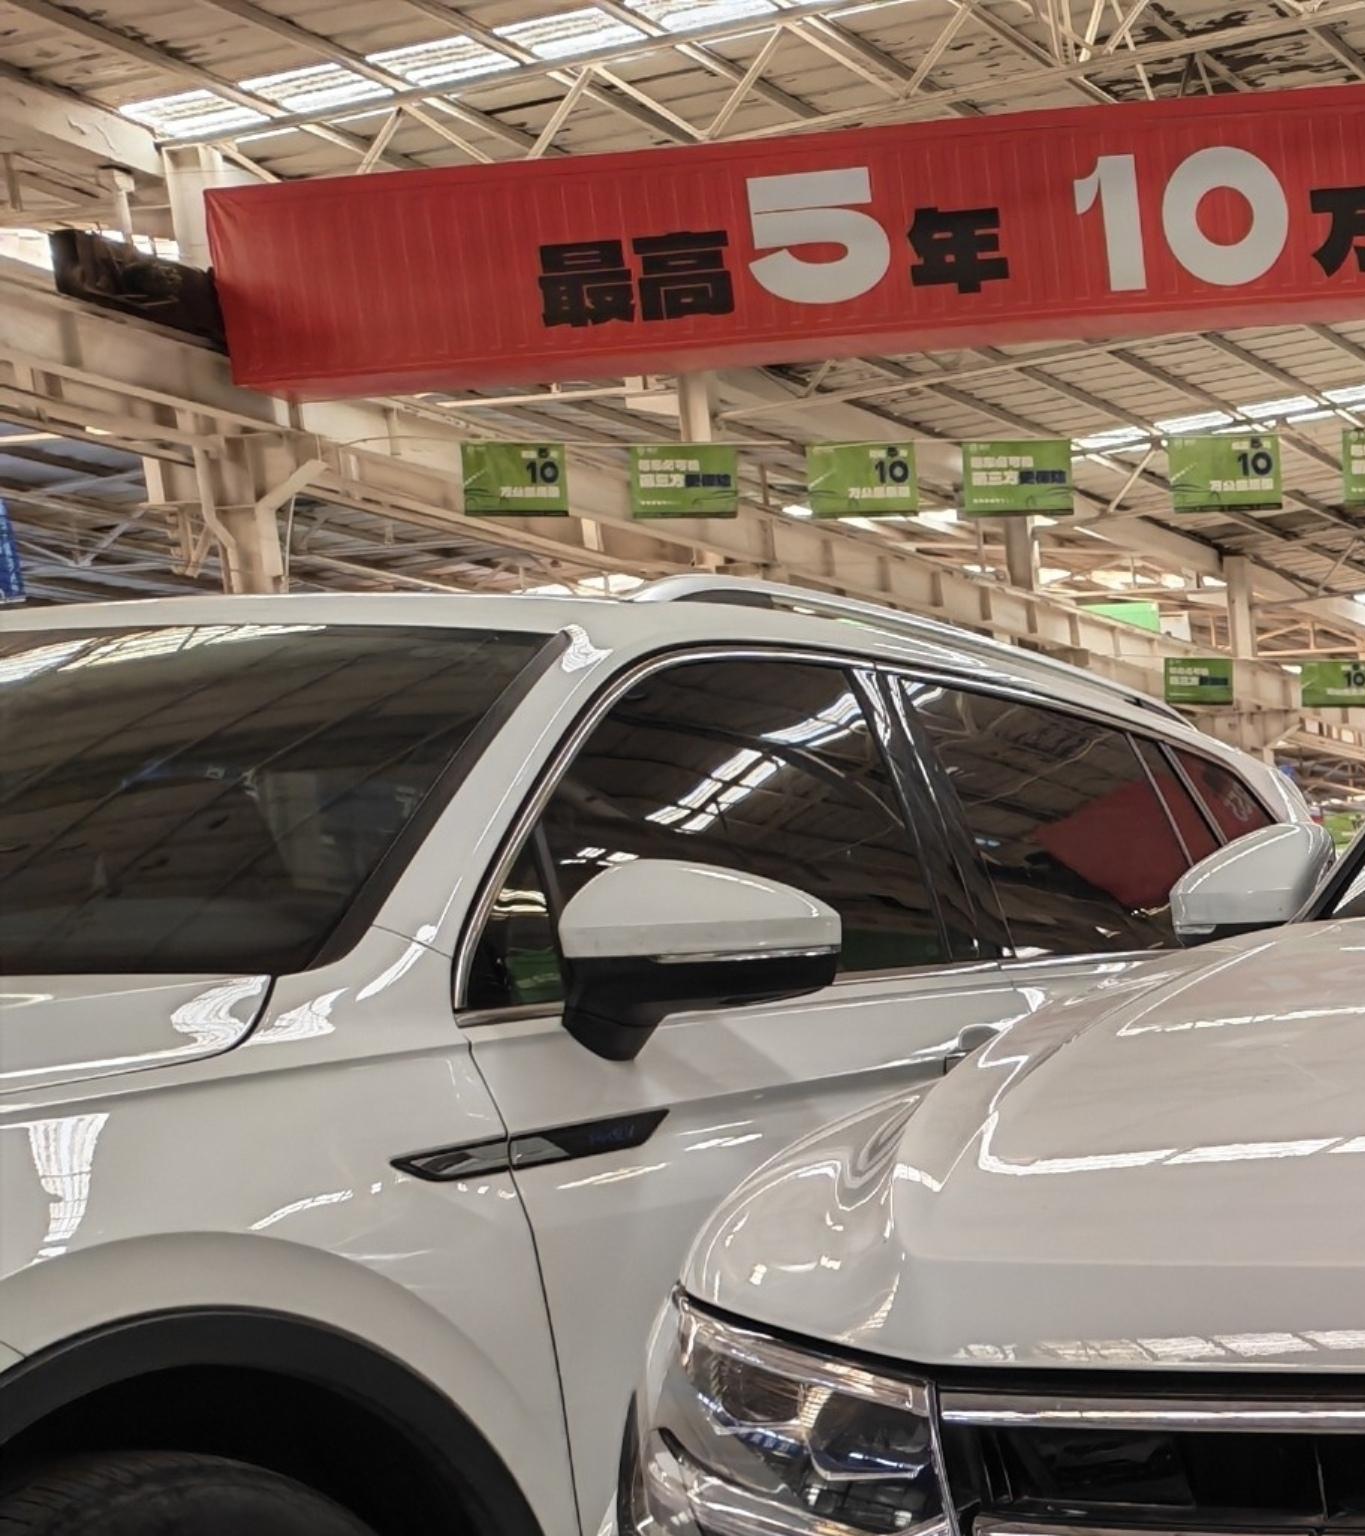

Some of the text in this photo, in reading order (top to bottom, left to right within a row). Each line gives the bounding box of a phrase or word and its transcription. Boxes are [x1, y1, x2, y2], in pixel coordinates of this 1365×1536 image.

[526, 460, 560, 484] 10
[874, 459, 909, 484] 10
[1237, 451, 1273, 476] 10
[1343, 670, 1365, 687] 10
